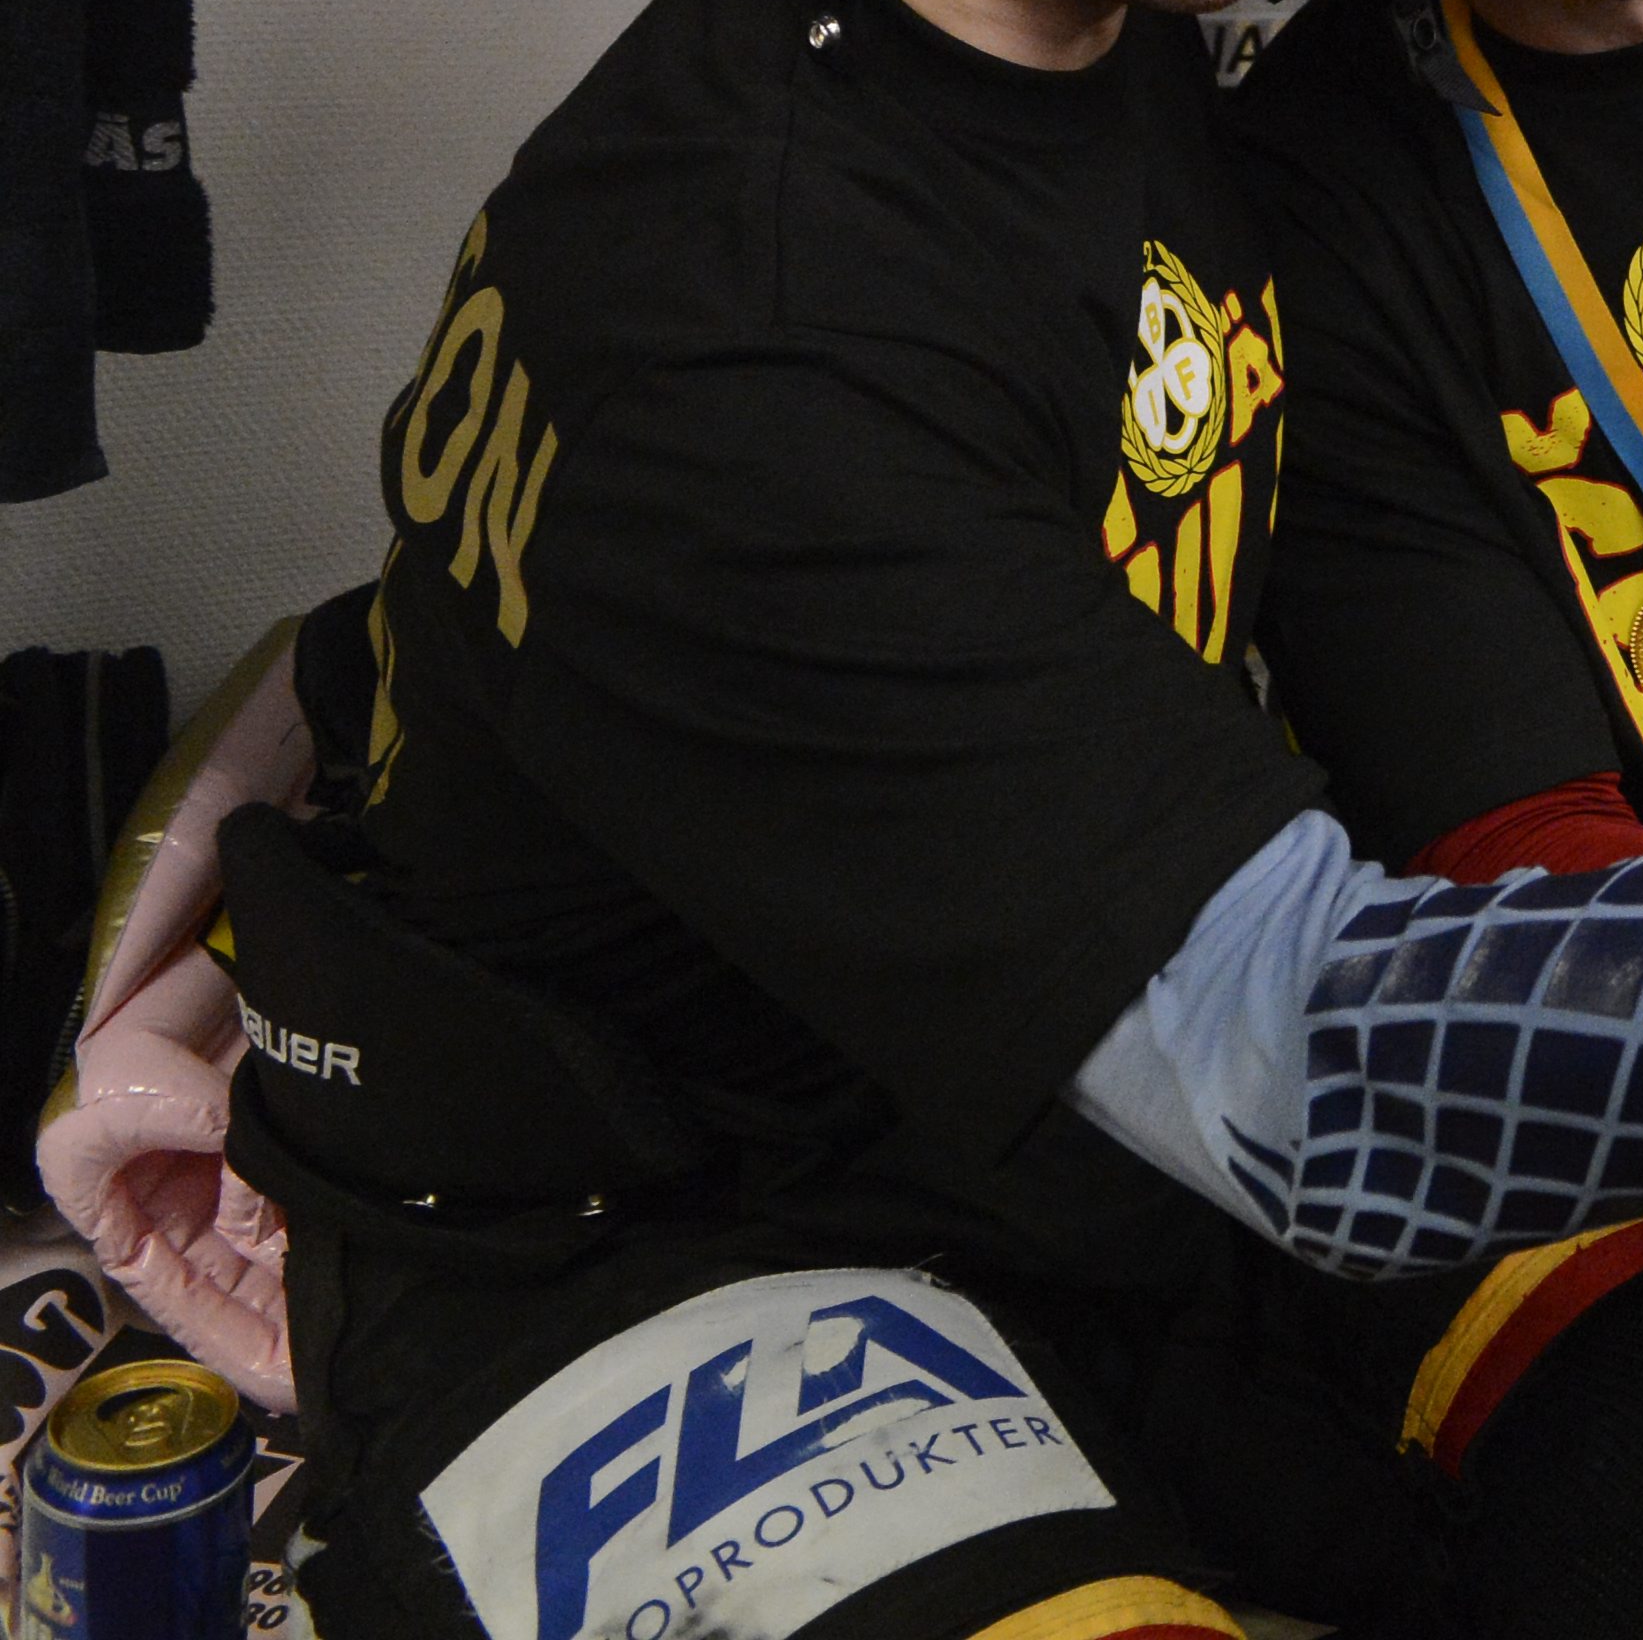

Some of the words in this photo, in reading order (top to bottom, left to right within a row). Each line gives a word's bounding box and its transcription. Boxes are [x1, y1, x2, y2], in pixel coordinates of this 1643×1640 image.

[90, 1483, 135, 1507] Beer
[141, 1482, 182, 1504] Cup
[535, 1294, 1030, 1640] FLA
[610, 1415, 1063, 1640] OPRODUKTER
